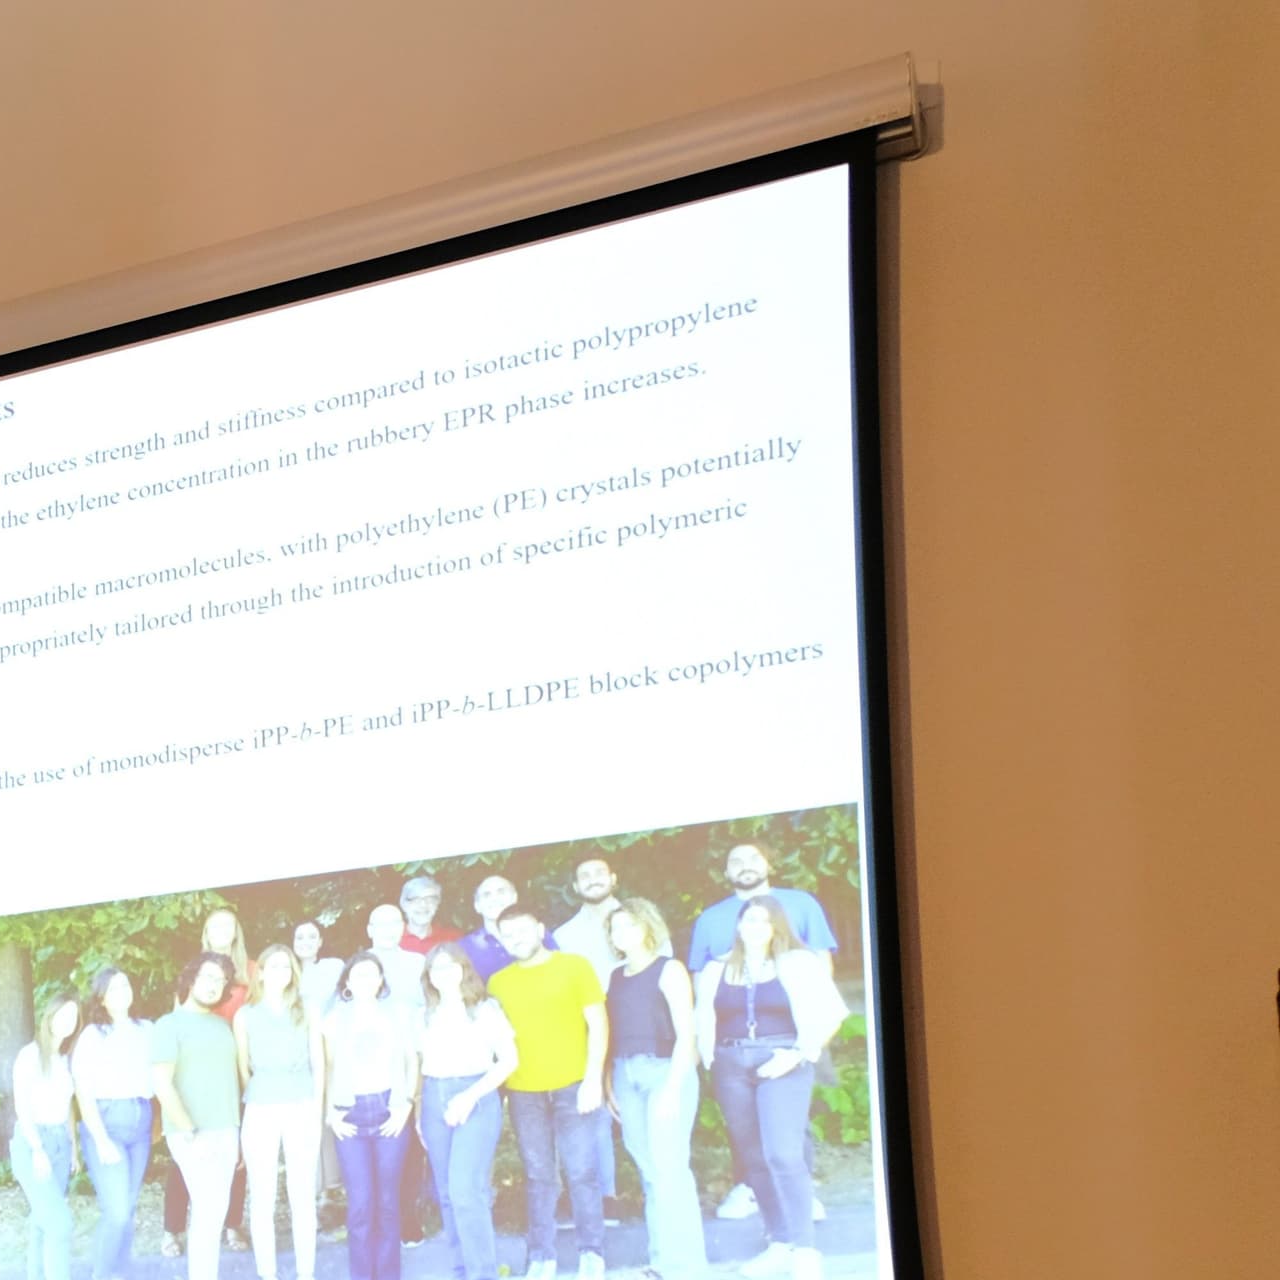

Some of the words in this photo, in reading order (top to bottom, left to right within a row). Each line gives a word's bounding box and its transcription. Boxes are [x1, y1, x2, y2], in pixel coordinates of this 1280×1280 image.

[0, 509, 30, 529] the
[35, 491, 121, 521] ethylene
[127, 457, 270, 502] concentration
[278, 448, 299, 469] in
[305, 440, 339, 463] the
[347, 420, 435, 454] rubbery
[443, 402, 497, 433] EPR
[504, 389, 575, 425] phase
[3, 456, 78, 487] reduces
[84, 431, 166, 468] strength
[172, 419, 210, 447] and
[217, 403, 307, 437] stiffness
[313, 369, 425, 414] compared
[433, 369, 456, 387] to
[464, 339, 564, 380] isotactic
[571, 297, 759, 361] polypropylene
[279, 531, 328, 557] with
[335, 504, 485, 554] polyethylene
[492, 487, 548, 519] (PE)
[555, 465, 652, 505] crystals
[660, 435, 803, 489] potentially
[114, 603, 193, 638] tailored
[200, 587, 283, 621] through
[290, 582, 324, 603] the
[332, 555, 472, 596] introduction
[479, 541, 508, 567] of
[512, 525, 608, 565] specific
[617, 497, 748, 548] polymeric
[33, 767, 66, 785] use
[72, 755, 96, 778] of
[99, 738, 245, 775] monodisperse
[361, 705, 403, 732] and
[588, 664, 660, 695] block
[667, 642, 824, 685] copolymers
